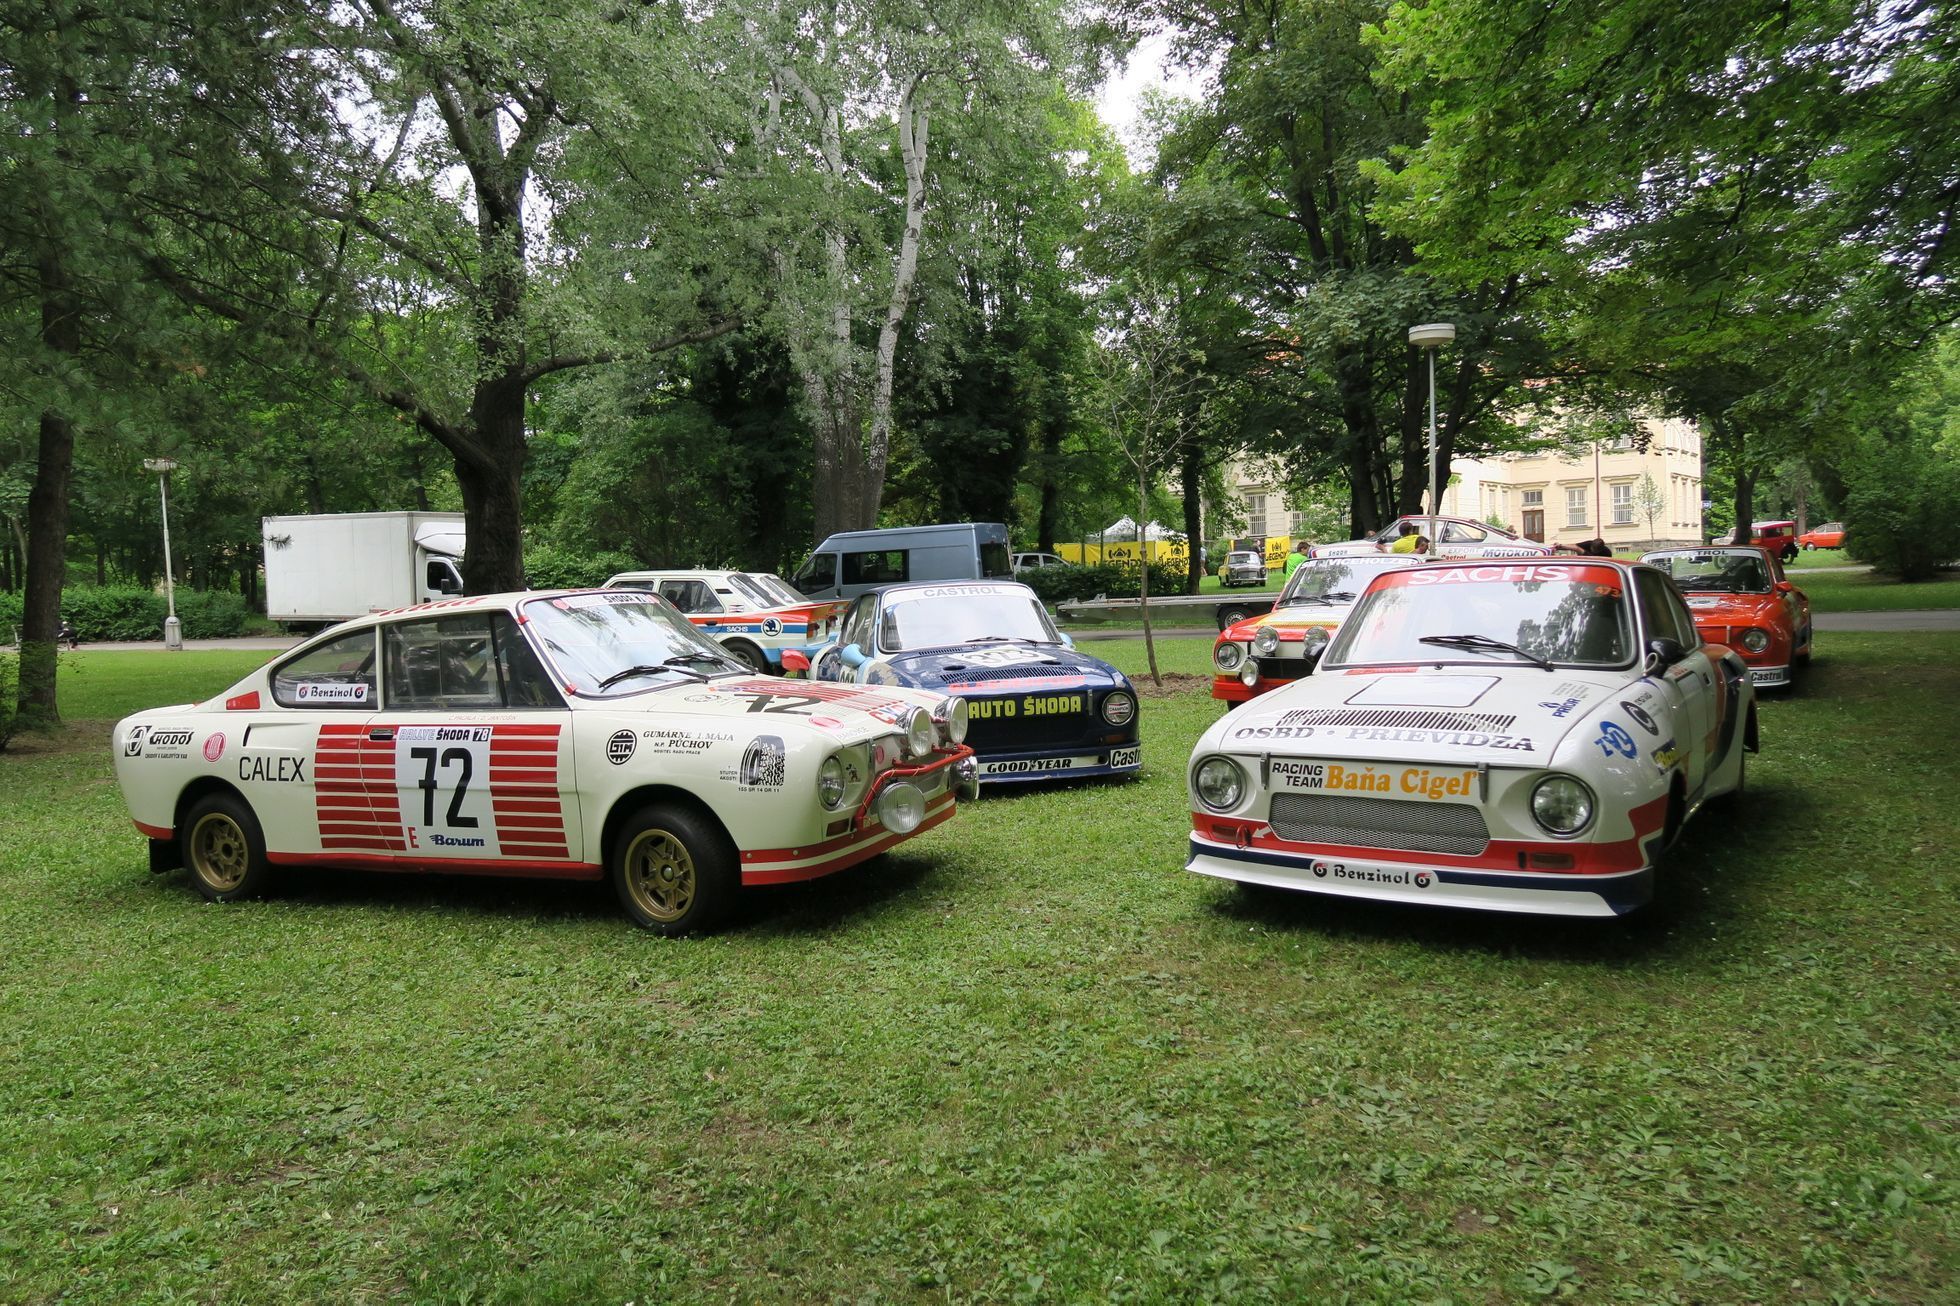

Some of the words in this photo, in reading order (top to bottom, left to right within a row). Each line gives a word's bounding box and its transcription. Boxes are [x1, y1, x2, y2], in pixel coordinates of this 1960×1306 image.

[1482, 549, 1538, 557] MOTOKOV
[1407, 565, 1570, 584] SACHS
[923, 586, 1003, 598] CASTROL
[310, 686, 353, 698] Benzinol
[733, 693, 822, 715] 72
[968, 700, 1016, 719] AUTO
[1023, 696, 1082, 716] ŠKODA
[1552, 697, 1581, 718] PRIOR
[436, 728, 470, 741] ŠKODA
[474, 728, 490, 741] 78
[668, 737, 713, 749] PÚCHOV
[1234, 726, 1315, 739] OSBD
[1344, 727, 1535, 751] PRIEVIDZA
[239, 756, 306, 782] CALEX
[1271, 762, 1324, 776] RACING
[1325, 765, 1391, 792] Baňa
[410, 747, 479, 828] 72
[1285, 775, 1323, 788] TEAM
[407, 826, 420, 848] E
[430, 834, 485, 847] Barum
[1333, 863, 1410, 885] Benzinol
